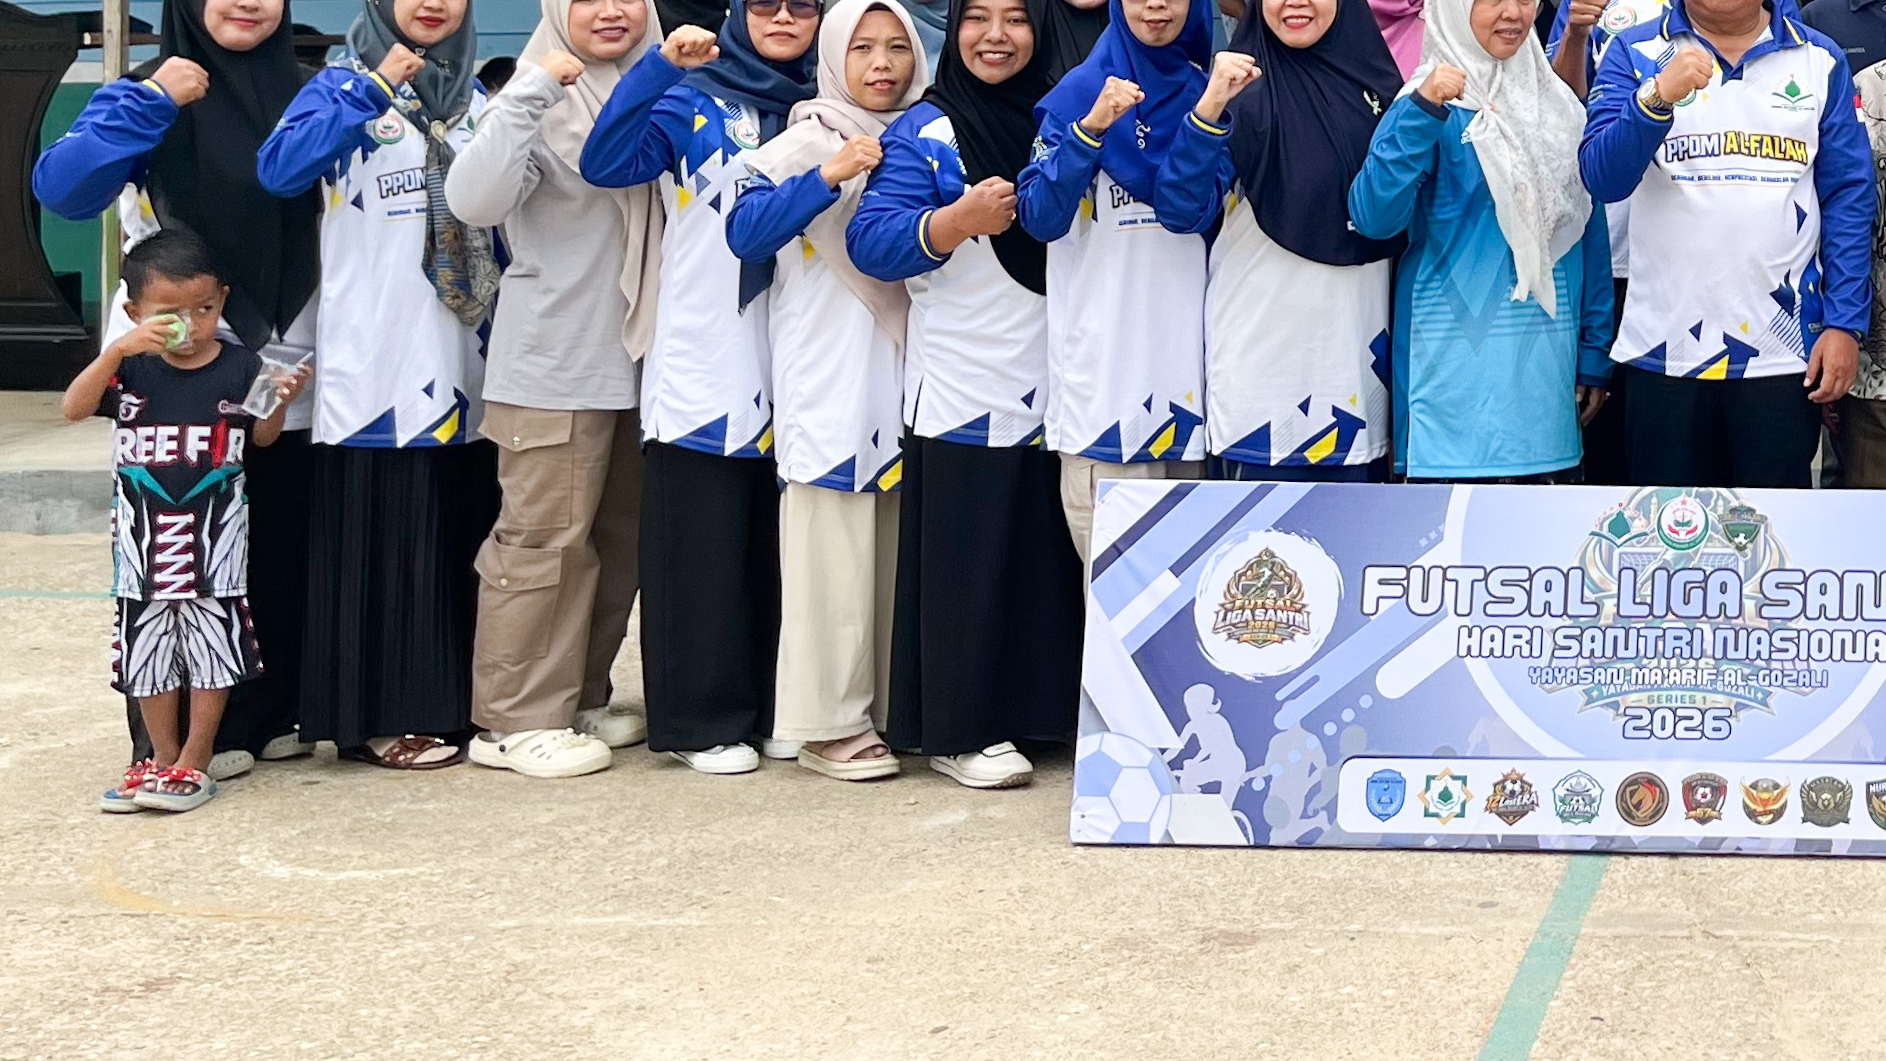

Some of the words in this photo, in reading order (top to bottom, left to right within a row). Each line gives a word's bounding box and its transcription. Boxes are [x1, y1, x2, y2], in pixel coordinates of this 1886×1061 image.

[1724, 130, 1808, 165] AL-FALAH
[116, 426, 180, 465] REE
[185, 420, 245, 467] FIR
[1235, 598, 1294, 610] FUTSAL
[1360, 565, 1600, 617] FUTSAL
[1617, 567, 1742, 619] LIGA
[1216, 609, 1253, 629] LIGA
[1254, 608, 1308, 631] SANTRI
[1457, 626, 1543, 658] HARI
[1553, 626, 1703, 660] SANTRI
[1528, 666, 1622, 685] YAYASAN
[1629, 667, 1718, 686] MA'ARIF
[1724, 669, 1829, 687] AL-GOZALI
[1647, 694, 1694, 705] SERIES
[1622, 707, 1732, 740] 2026
